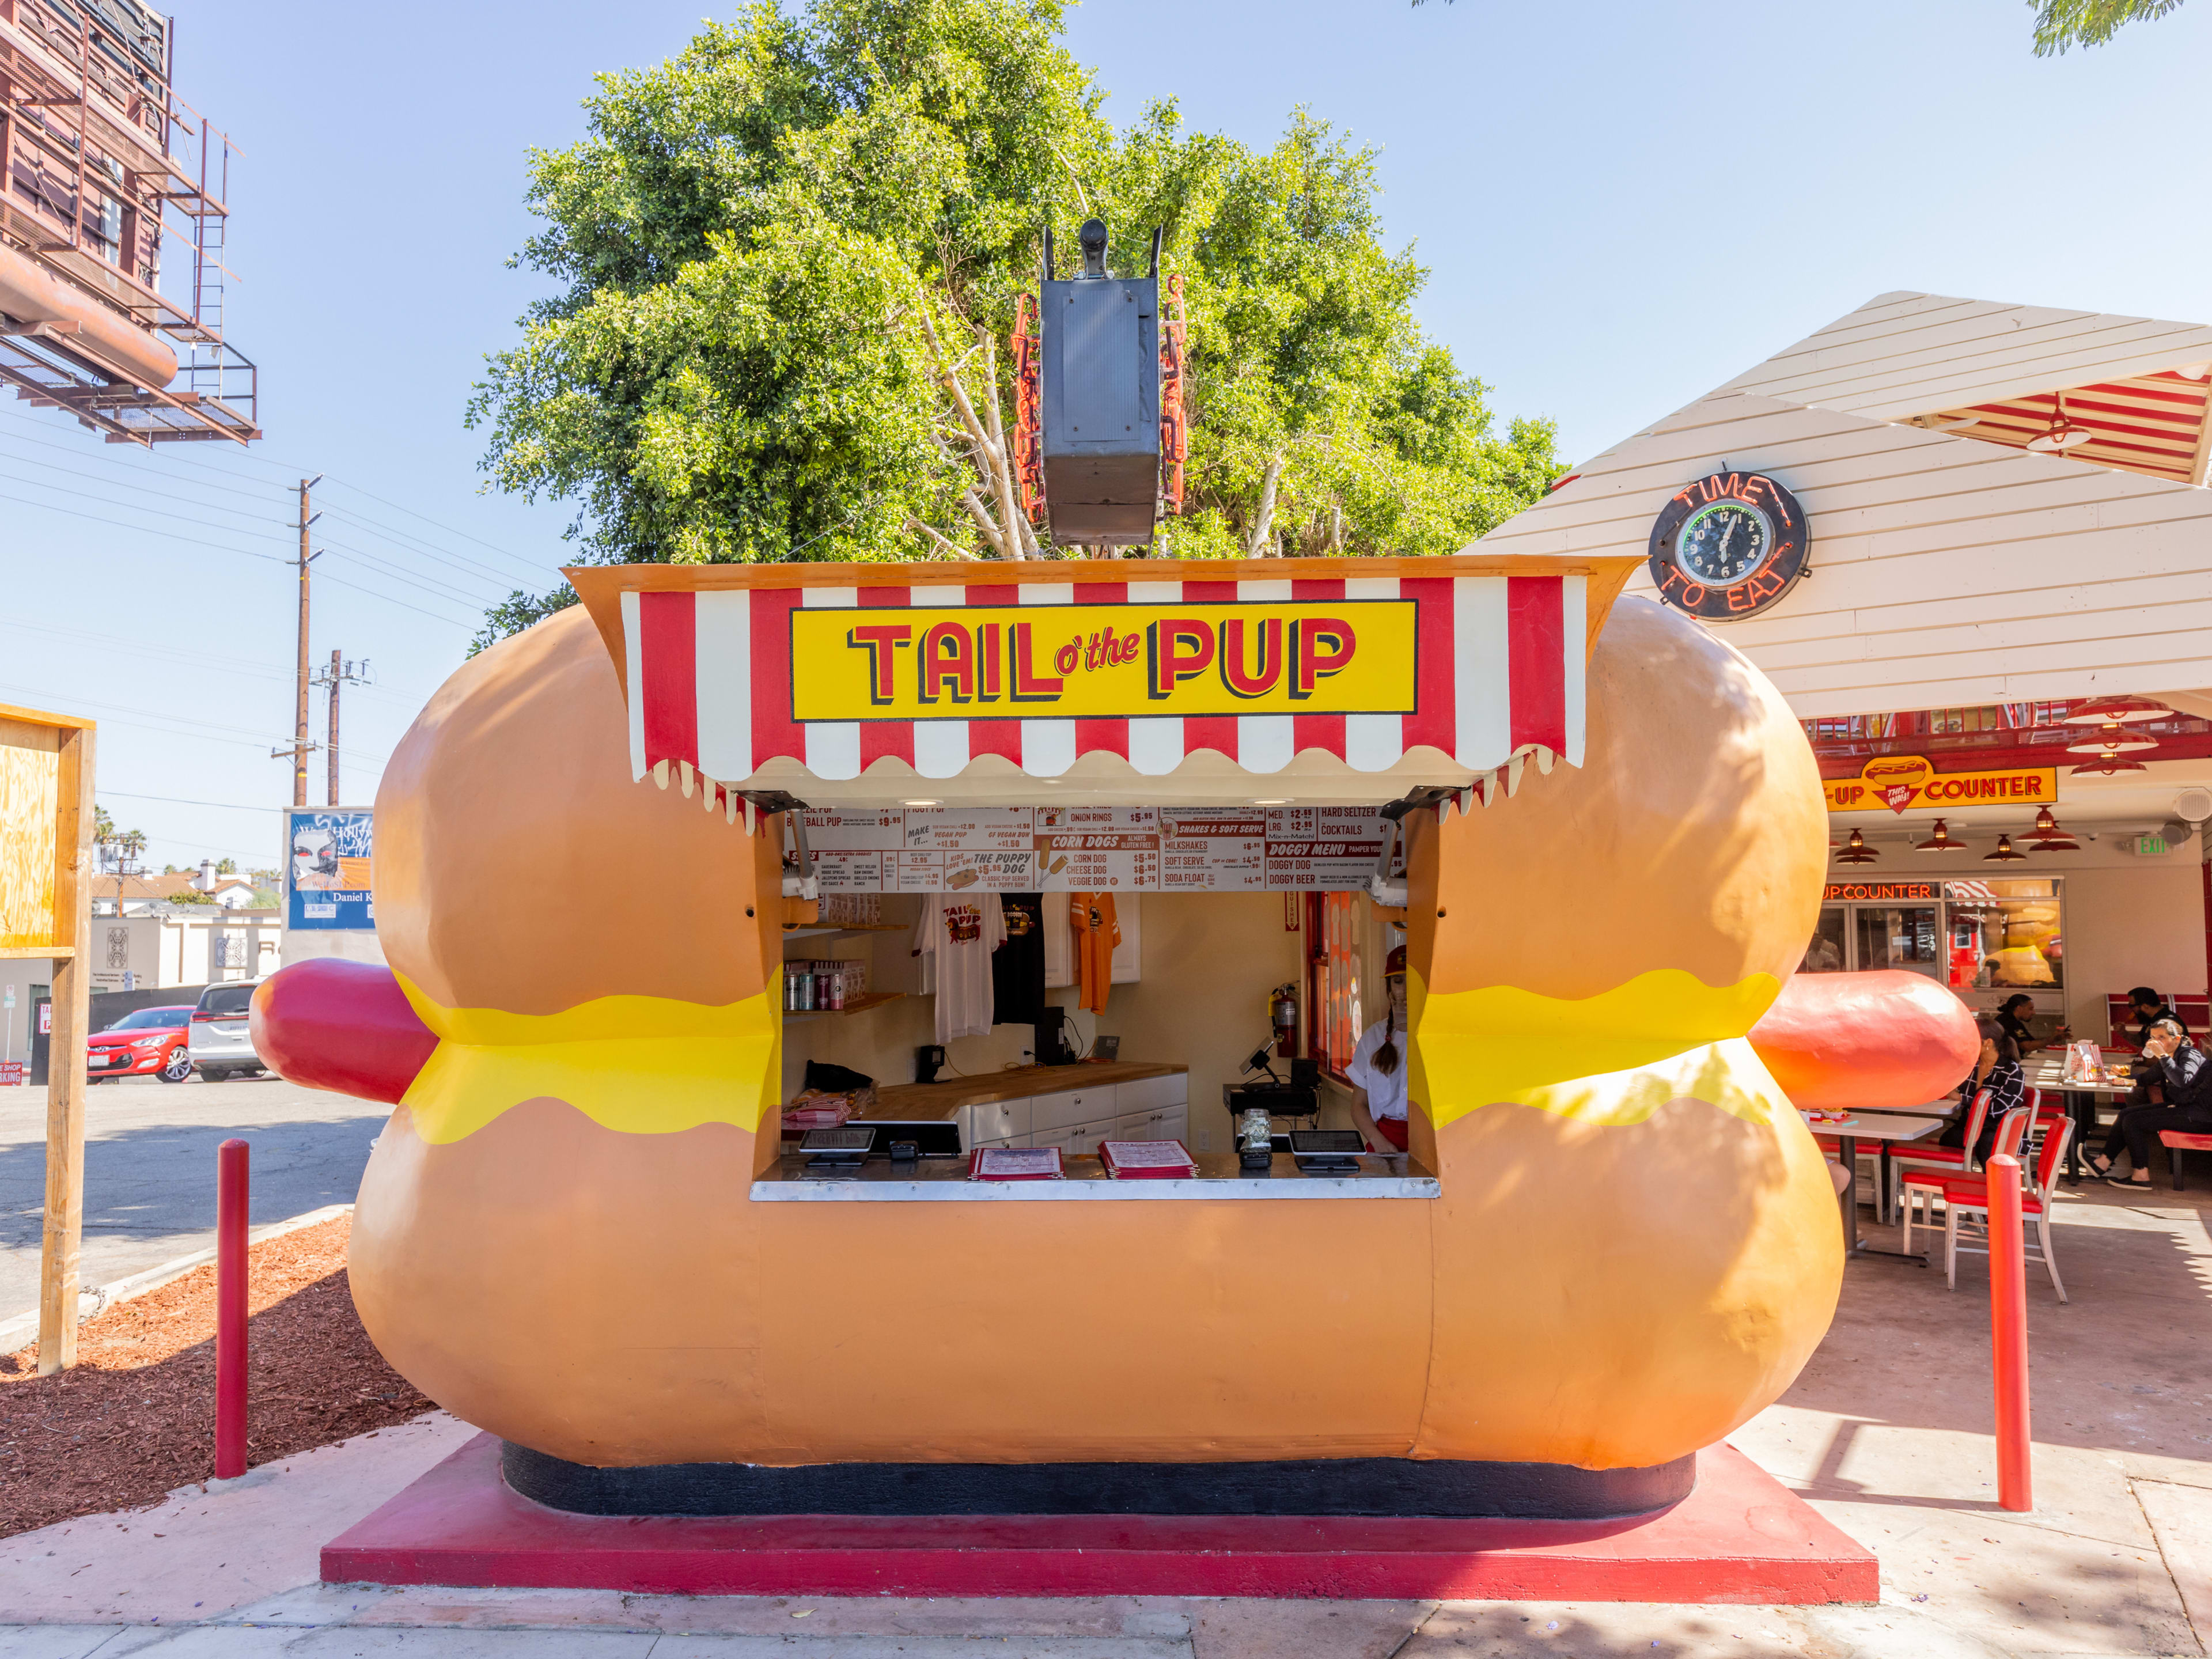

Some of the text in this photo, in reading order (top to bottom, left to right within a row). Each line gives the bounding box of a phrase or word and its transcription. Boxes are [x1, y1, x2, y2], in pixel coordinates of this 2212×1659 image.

[1673, 473, 1763, 507] TIME
[1719, 512, 1729, 522] 12
[1737, 513, 1741, 524] 1
[1703, 519, 1711, 529] 11
[1748, 521, 1755, 531] 2
[1694, 530, 1705, 540] 10
[1751, 535, 1760, 545] 3
[1690, 544, 1698, 555] 9
[1747, 549, 1756, 559] 4
[1695, 556, 1702, 566] 8
[1737, 561, 1745, 571] 5
[1707, 565, 1714, 574] 7
[1721, 567, 1729, 577] 6
[1661, 565, 1785, 611] TO EAT
[847, 621, 1064, 706] TAIL
[1147, 618, 1356, 700] PUP
[1823, 775, 2042, 805] -UP COUNTER
[1887, 786, 1906, 797] THIS
[1888, 791, 1910, 806] WAY!
[1268, 810, 1285, 819] MED.
[1321, 807, 1376, 817] HARD SELTZER
[827, 817, 842, 827] PUP
[879, 816, 902, 827] $9.95
[1071, 813, 1112, 822] ONION RINGS
[1130, 812, 1153, 823] $5.95
[1179, 825, 1264, 834] SHAKES & SOFT SERVE
[1268, 822, 1283, 831] LRG.
[1290, 821, 1312, 831] $2.95
[1321, 825, 1362, 835] COCKTAILS
[908, 825, 930, 838] MAKE
[914, 837, 929, 846] IT...
[1052, 836, 1119, 848] CORN DOGS
[1165, 840, 1208, 850] MILKSHAKES
[1268, 843, 1346, 855] DOGGY MENU
[950, 853, 964, 862] KIDS
[974, 853, 1031, 863] THE PUPPY
[1074, 854, 1107, 863] CORN DOG
[1134, 853, 1156, 863] $5.50
[1165, 857, 1205, 865] SOFT SERVE
[946, 861, 960, 870] LOVE
[978, 865, 1001, 875] $5.95
[1002, 863, 1025, 874] DOG
[1066, 866, 1107, 874] CHEESE DOG
[1134, 865, 1156, 874] $6.50
[1268, 860, 1310, 870] DOGGY DOG
[1068, 877, 1107, 885] VEGGIE DOG
[1134, 876, 1156, 886] $6.75
[1165, 873, 1205, 882] SODA FLOAT
[1269, 874, 1315, 884] DOGGY BEER
[333, 892, 363, 902] Daniel
[1843, 885, 1931, 900] COUNTER
[943, 906, 968, 917] TAIL
[959, 915, 981, 925] PUP
